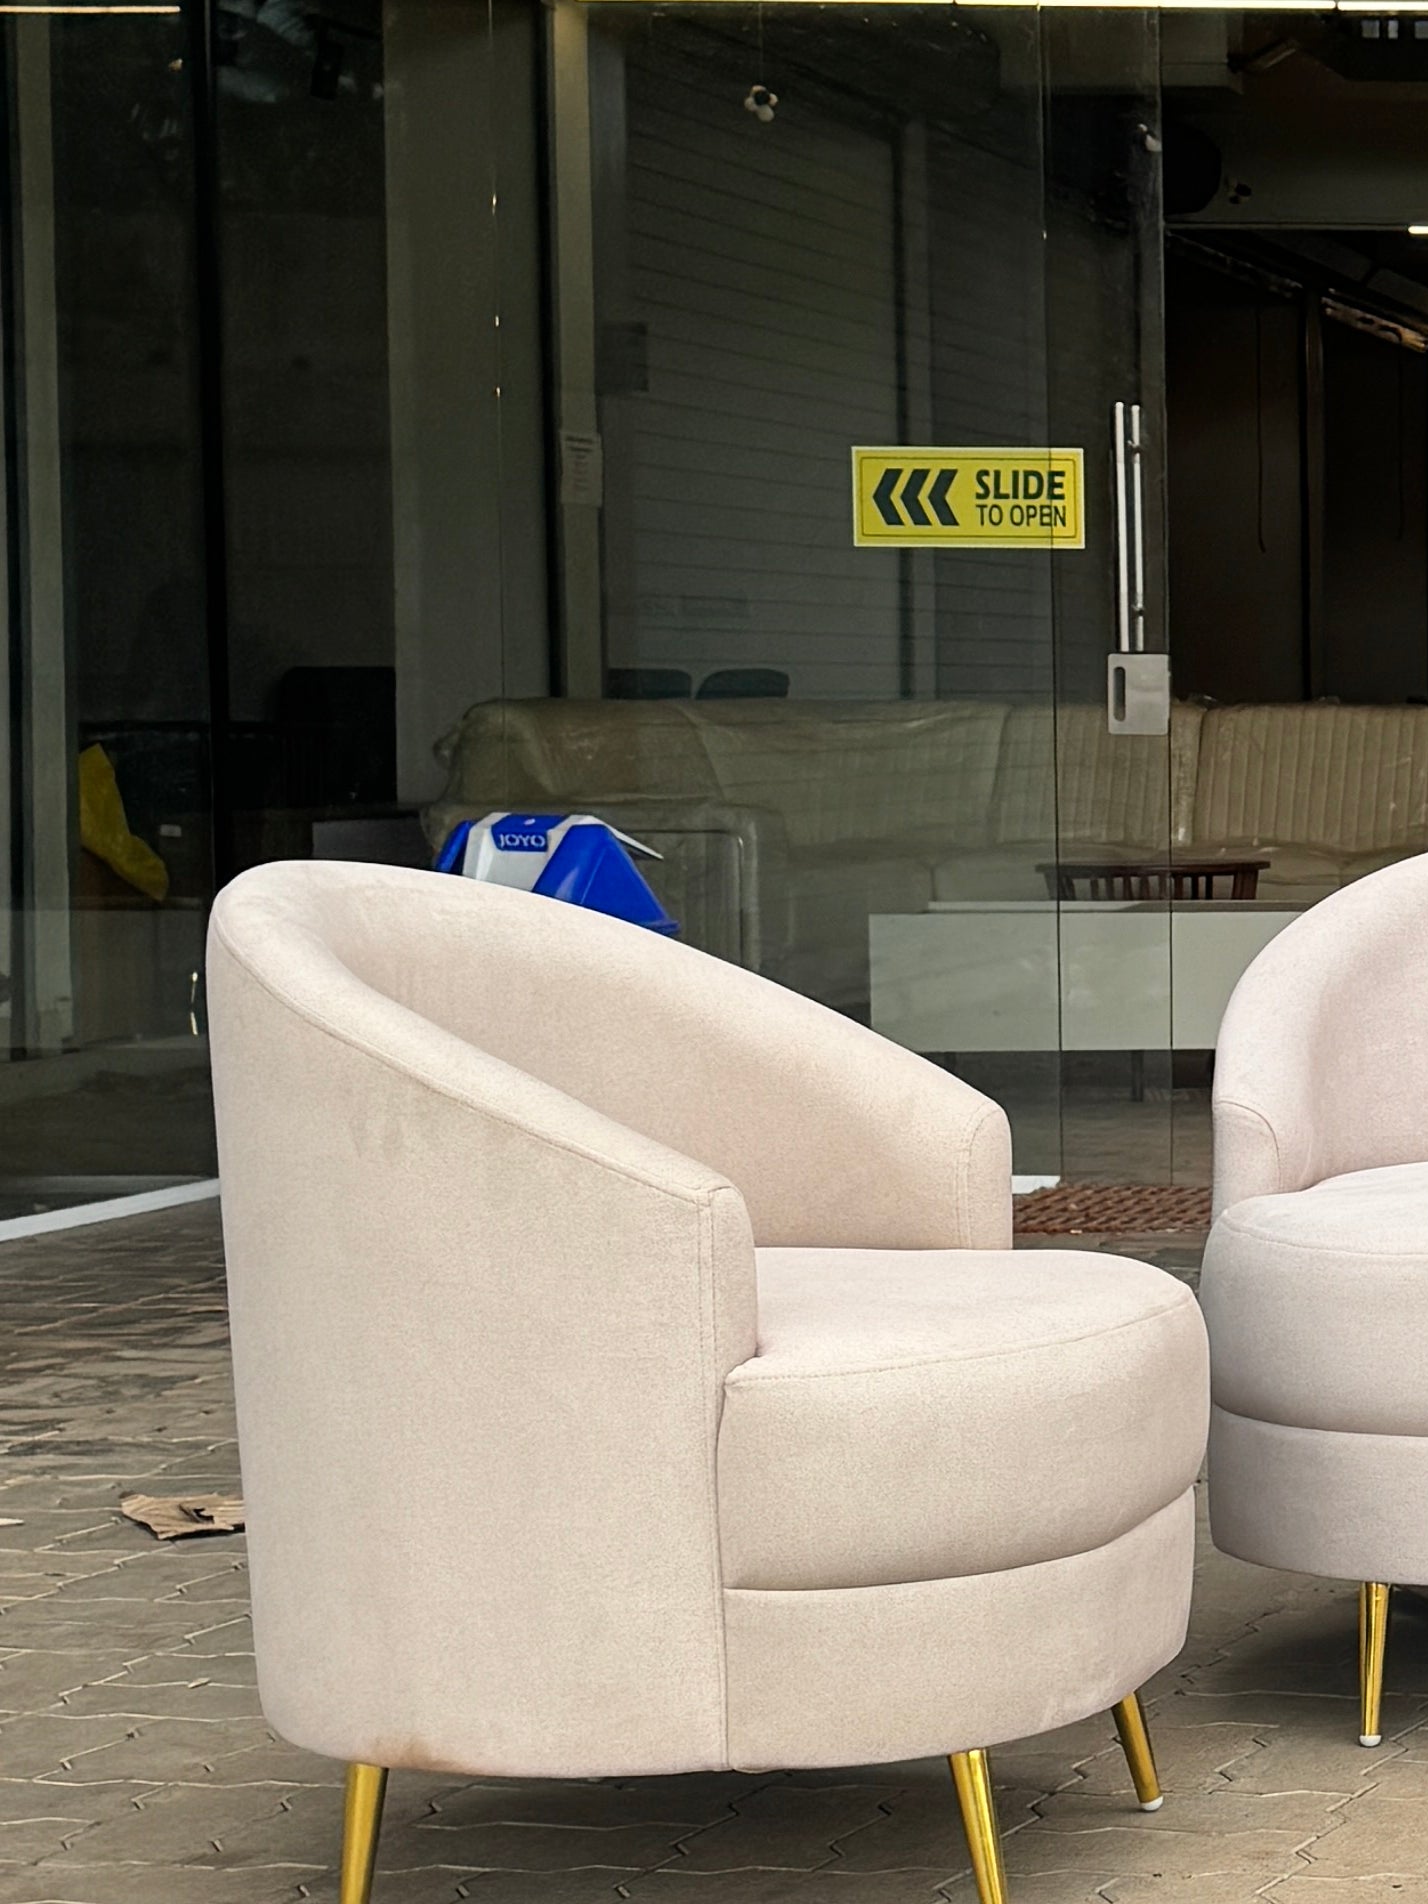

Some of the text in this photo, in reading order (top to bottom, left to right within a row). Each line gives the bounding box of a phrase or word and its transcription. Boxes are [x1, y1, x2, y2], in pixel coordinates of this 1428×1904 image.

[976, 470, 1065, 500] SLIDE
[977, 505, 1066, 527] TO OPEN
[499, 833, 545, 848] JOYO
